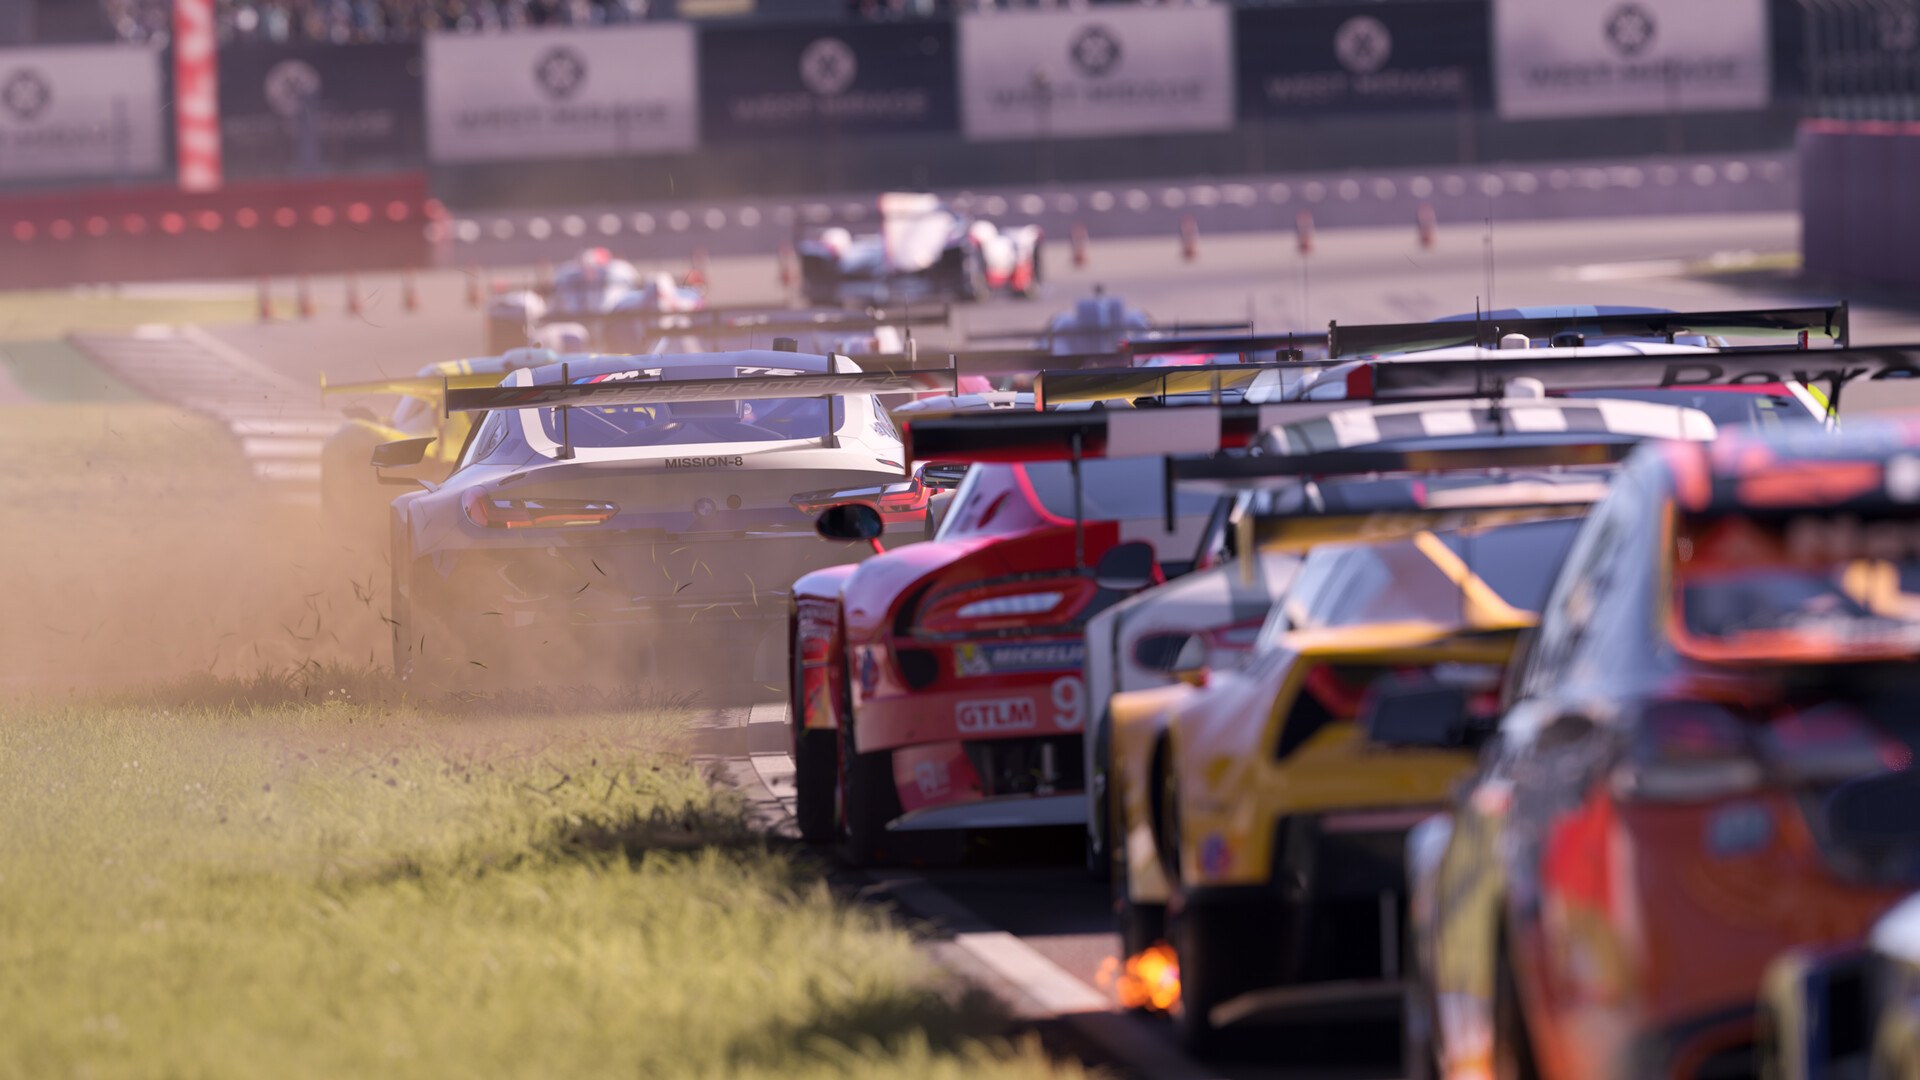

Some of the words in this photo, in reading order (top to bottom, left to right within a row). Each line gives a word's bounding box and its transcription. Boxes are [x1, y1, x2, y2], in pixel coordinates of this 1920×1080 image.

[665, 456, 743, 469] MISSION-8
[960, 702, 1033, 726] GTLM
[1051, 675, 1086, 731] 9
